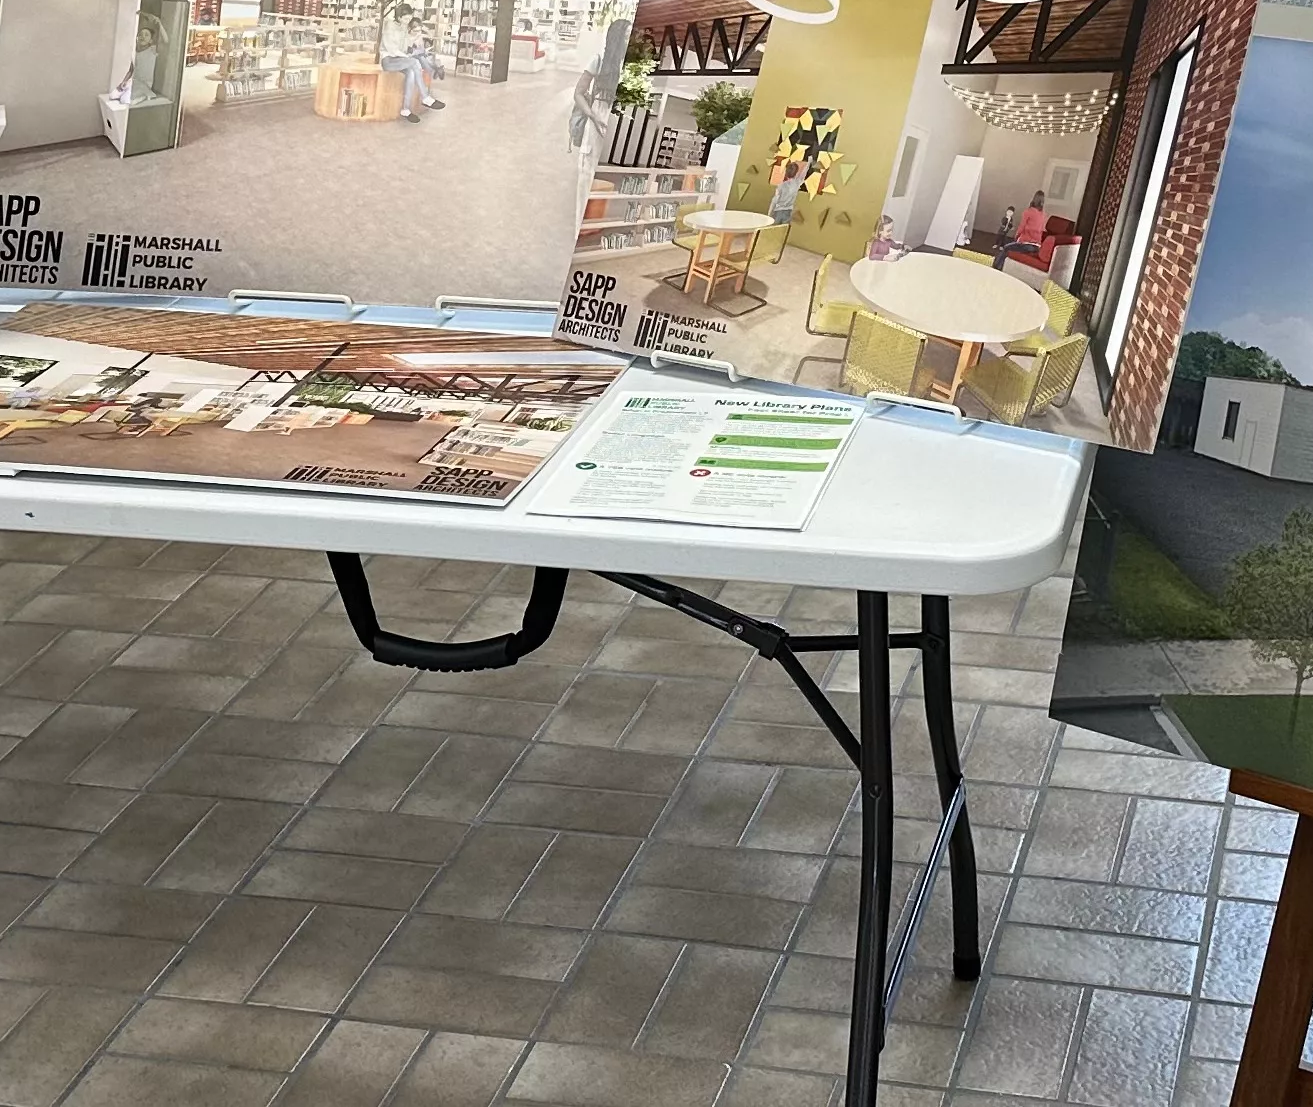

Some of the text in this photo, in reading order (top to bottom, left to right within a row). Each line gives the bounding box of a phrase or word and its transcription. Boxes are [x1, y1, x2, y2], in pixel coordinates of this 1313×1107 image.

[133, 235, 223, 252] MARSHALL
[131, 254, 194, 270] PUBLIC
[129, 274, 208, 292] LIBRARY
[570, 270, 617, 299] SAPP
[562, 294, 628, 328] DESIGN
[557, 318, 621, 343] ARCHITECTS
[670, 314, 728, 334] MARSHALL
[667, 327, 708, 344] PUBLIC
[663, 342, 715, 360] LIBRARY
[714, 399, 853, 412] New Library Plans
[328, 472, 381, 481] PUBLIC
[333, 467, 407, 478] MARSHALL
[430, 465, 494, 479] SAPP
[320, 478, 389, 488] LIBRARY
[412, 483, 500, 497] ARCHITECTS
[420, 474, 508, 492] DESIGN
